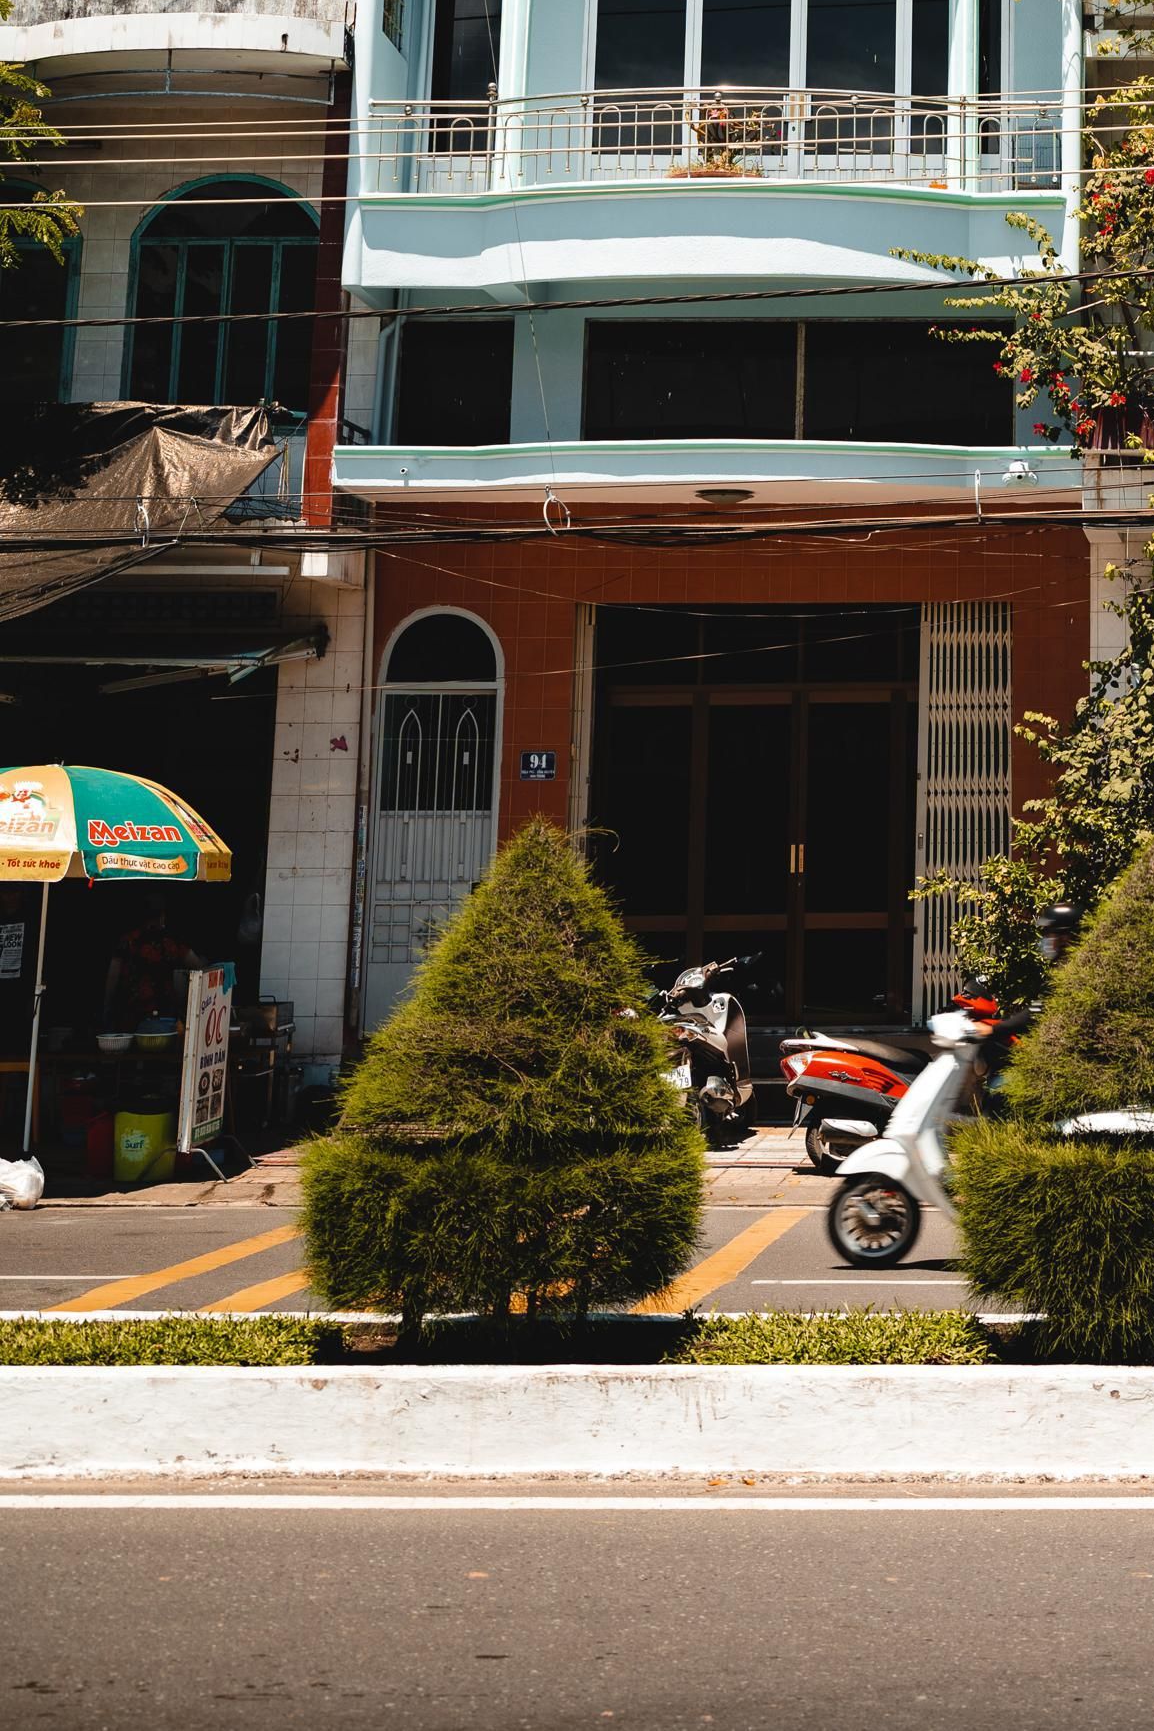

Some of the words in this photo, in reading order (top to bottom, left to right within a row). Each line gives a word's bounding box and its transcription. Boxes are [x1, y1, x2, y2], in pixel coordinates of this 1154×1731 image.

[530, 754, 546, 768] 94
[0, 818, 54, 835] eizan
[88, 820, 183, 846] Meizan
[153, 862, 166, 870] cao
[125, 1139, 145, 1149] Surf
